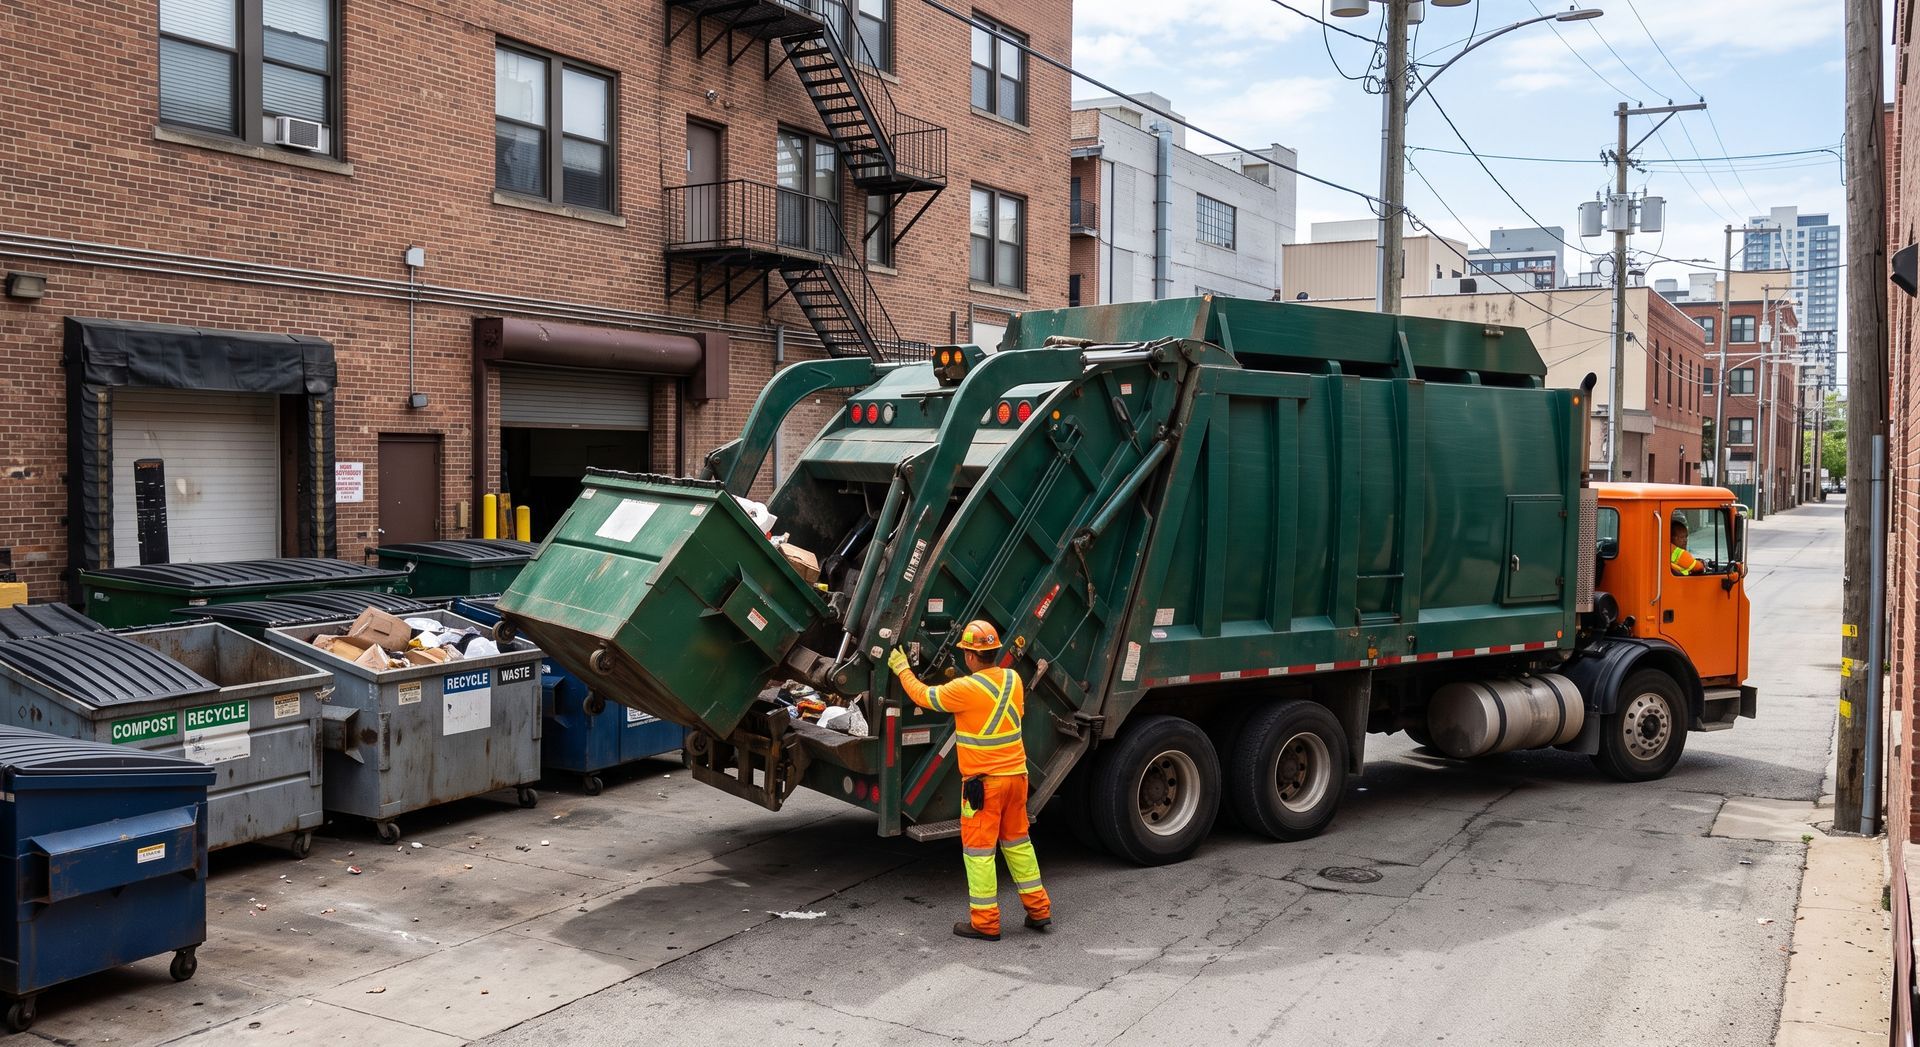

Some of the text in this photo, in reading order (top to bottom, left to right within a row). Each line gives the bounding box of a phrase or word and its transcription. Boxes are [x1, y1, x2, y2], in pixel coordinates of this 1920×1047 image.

[448, 673, 488, 690] RECYCLE
[501, 667, 530, 681] WASTE
[188, 704, 245, 726] RECYCLE
[113, 716, 175, 739] COMPOST
